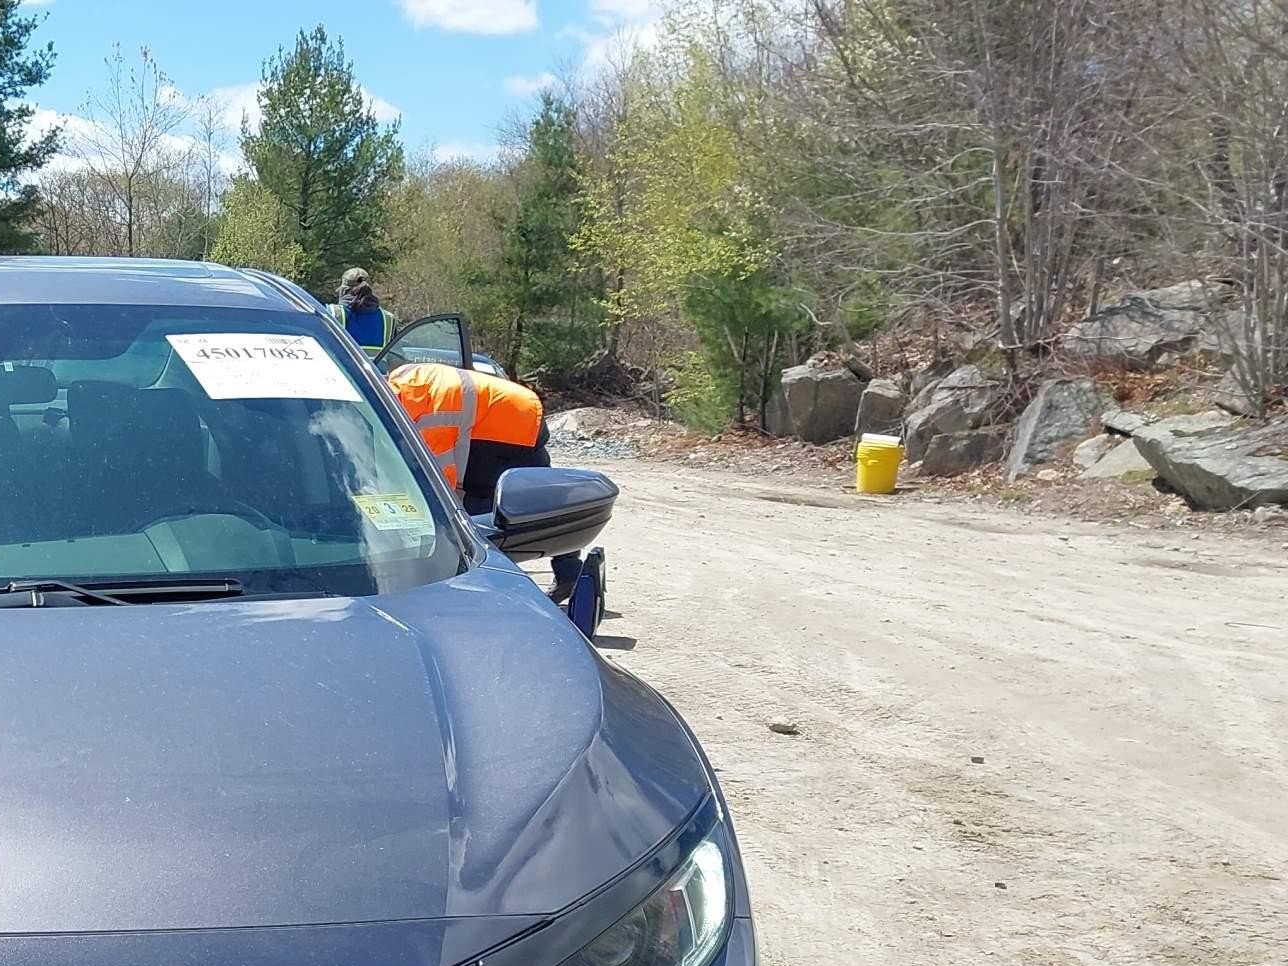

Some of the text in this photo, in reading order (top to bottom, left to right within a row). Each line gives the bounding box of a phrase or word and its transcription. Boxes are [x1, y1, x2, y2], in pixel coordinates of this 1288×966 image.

[196, 346, 315, 361] 45017082
[364, 506, 380, 514] 20
[383, 502, 396, 514] 3
